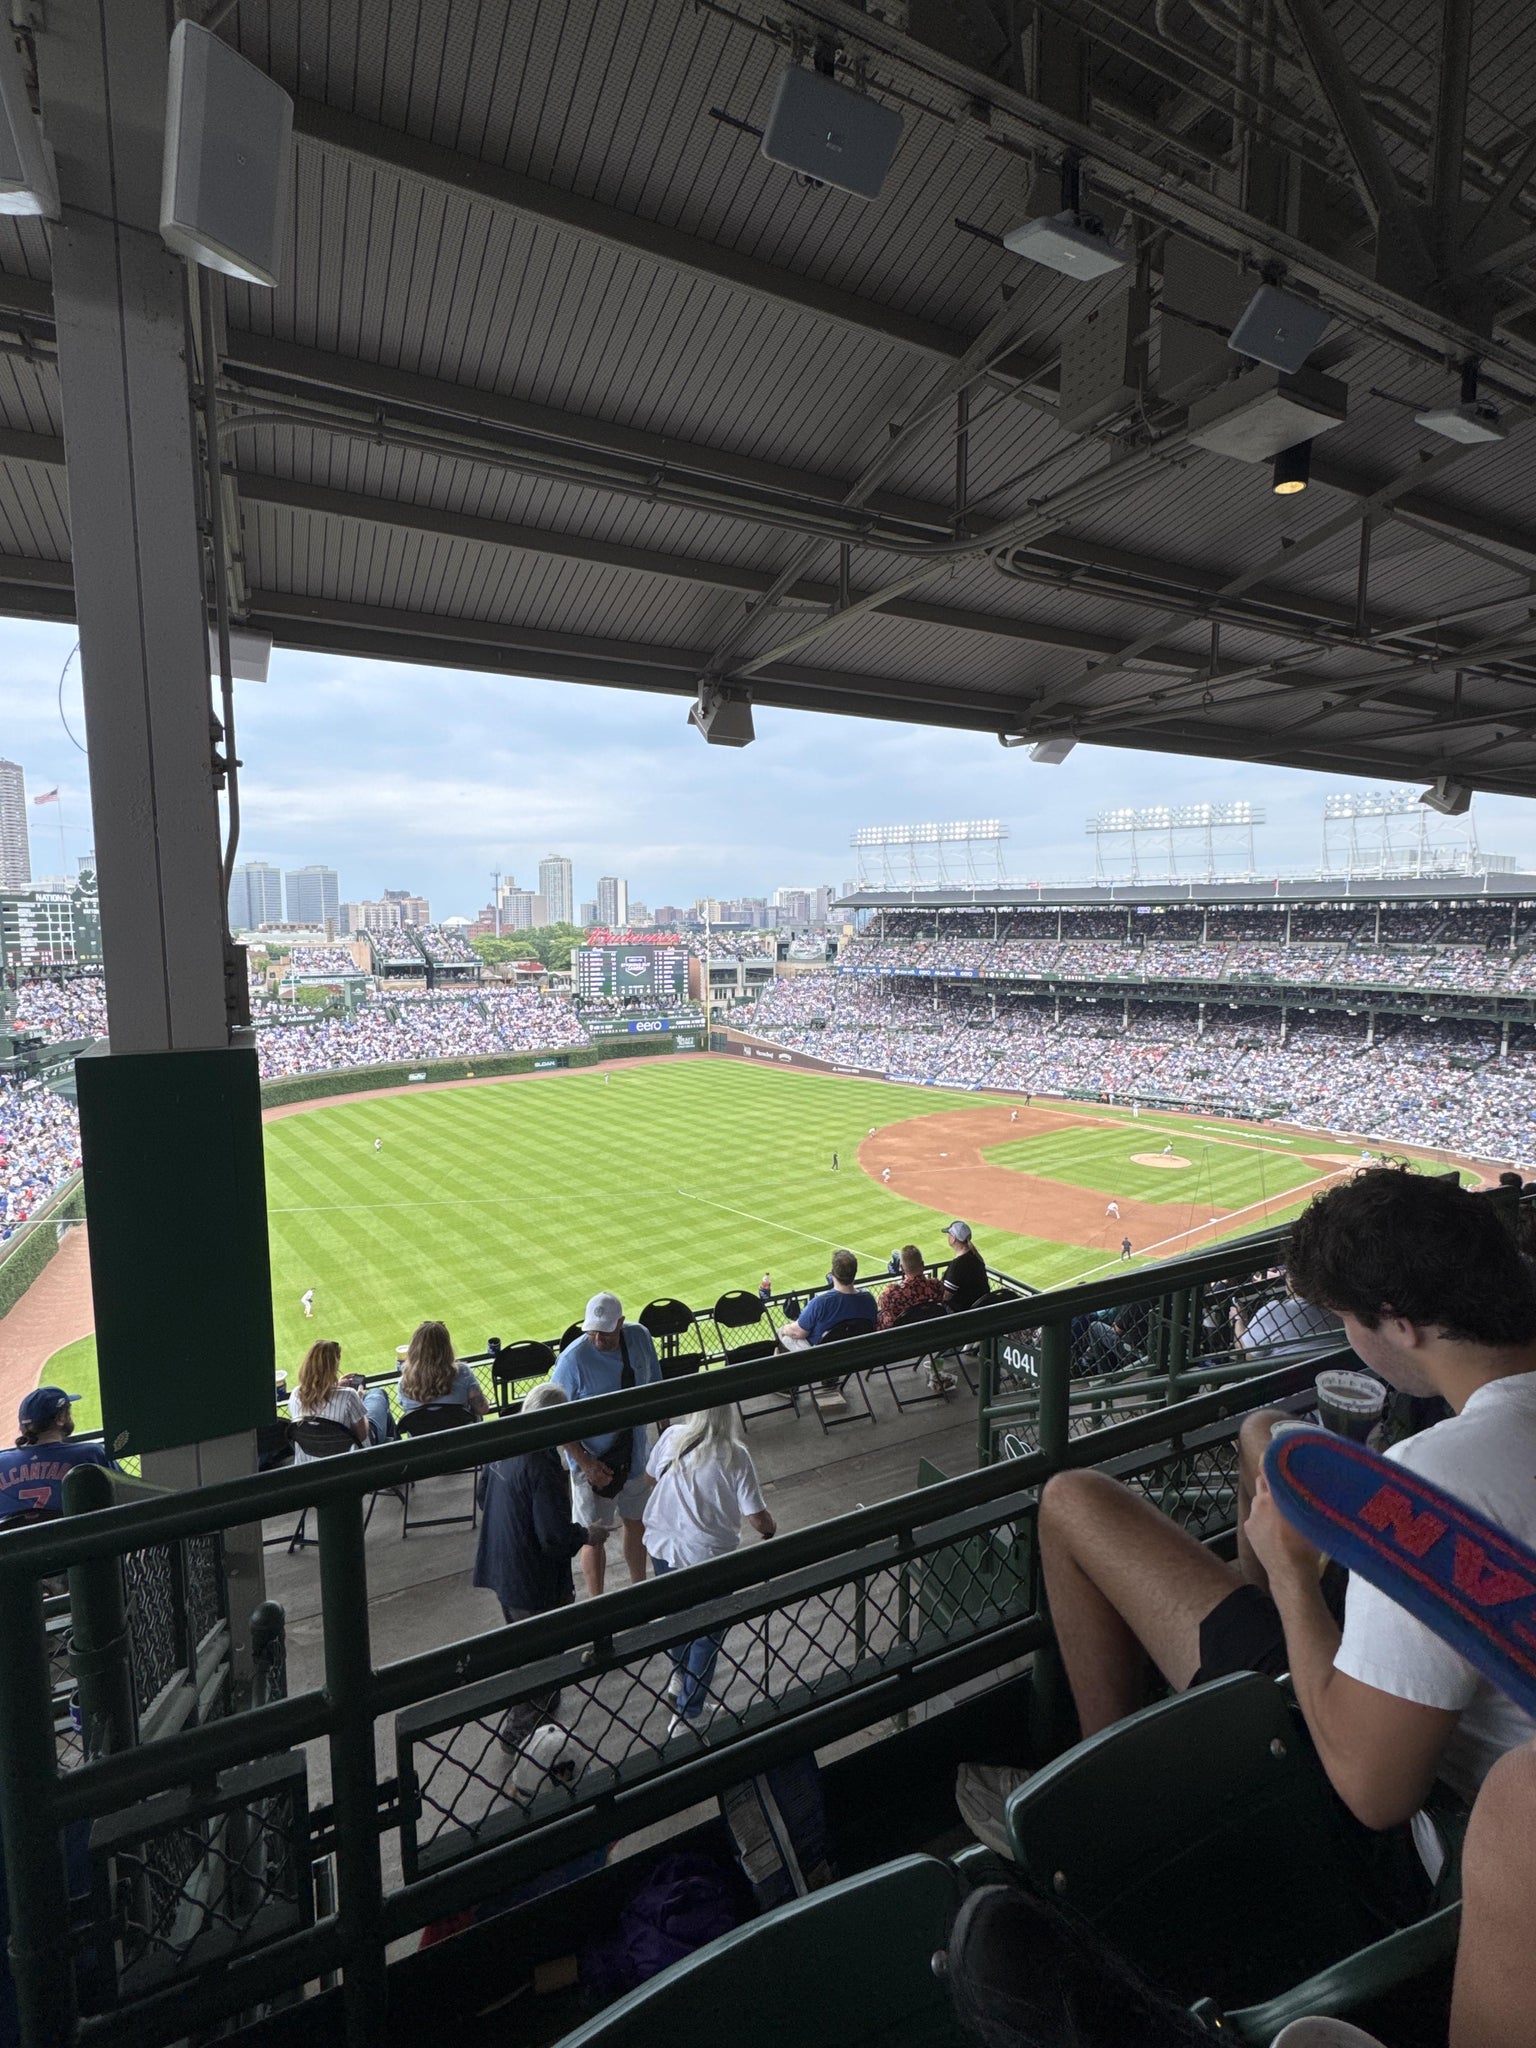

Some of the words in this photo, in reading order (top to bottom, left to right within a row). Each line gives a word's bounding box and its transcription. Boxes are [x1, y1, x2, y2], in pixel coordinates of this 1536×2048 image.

[35, 893, 73, 902] NATIONAL
[583, 926, 680, 945] Budweiser
[288, 1014, 316, 1022] Advocate
[636, 1020, 662, 1032] eero
[1003, 1345, 1038, 1378] 404L
[19, 1487, 52, 1509] 7
